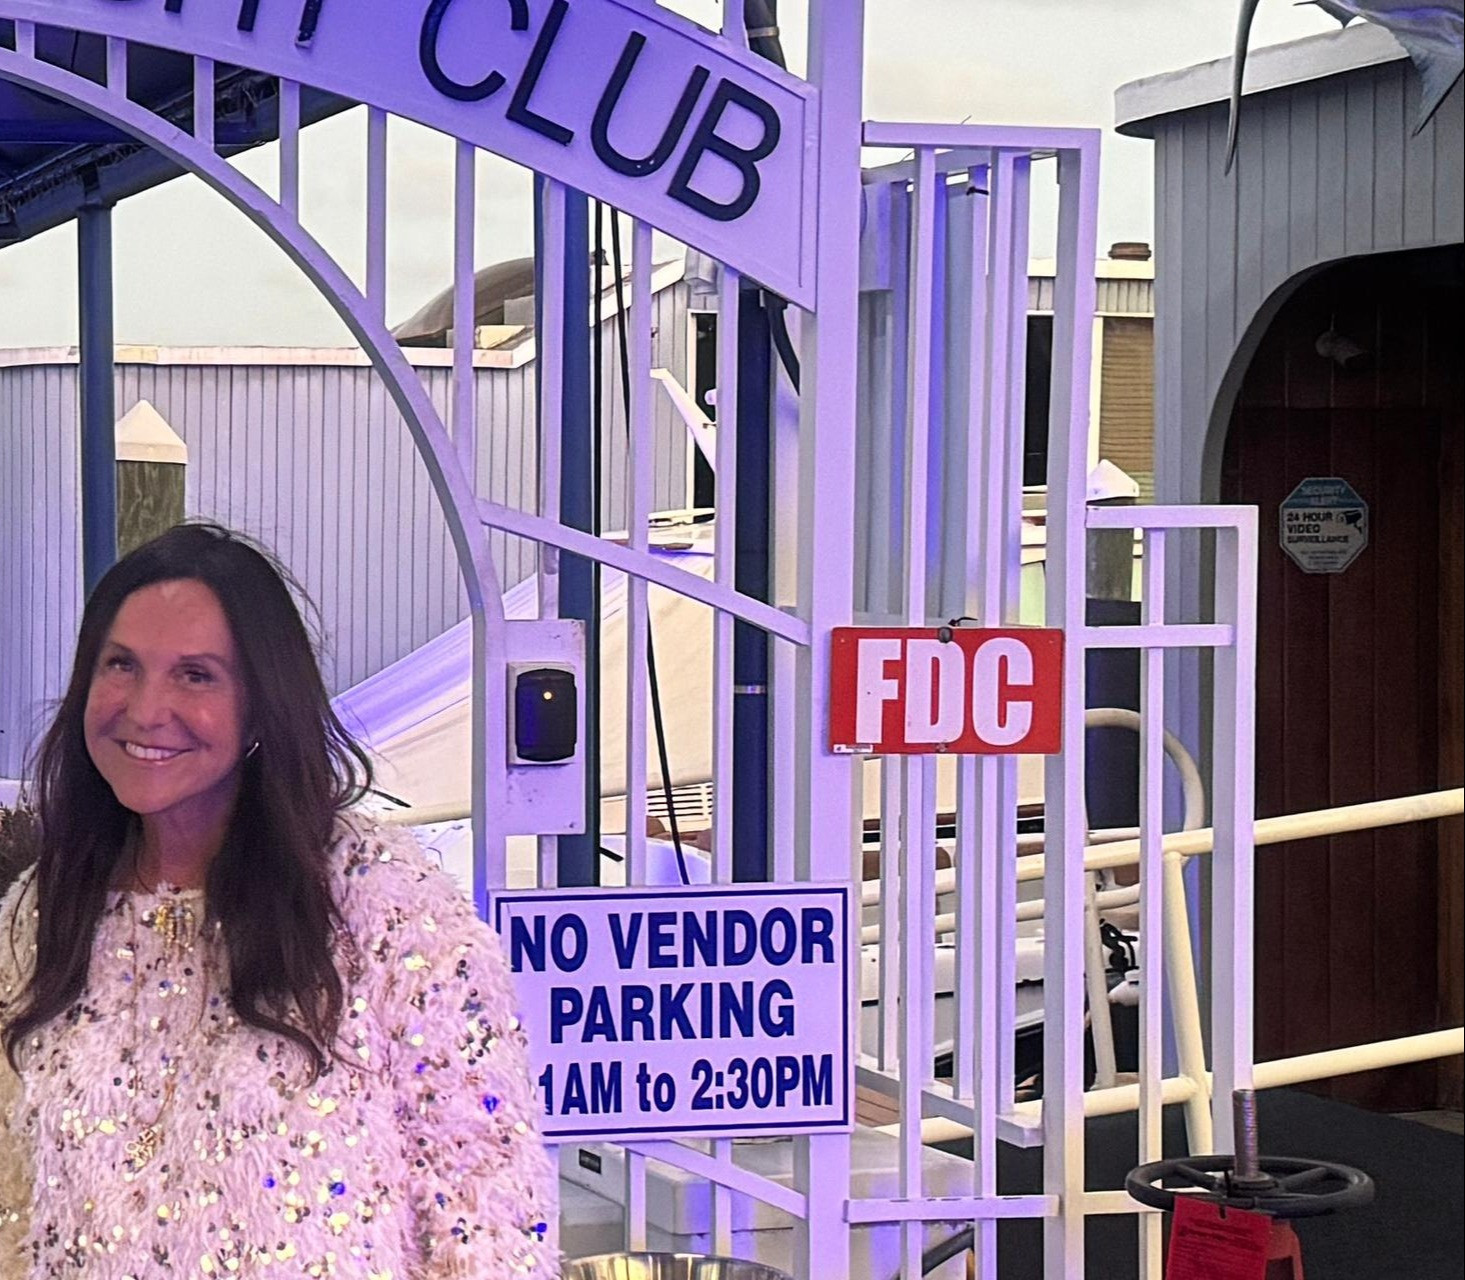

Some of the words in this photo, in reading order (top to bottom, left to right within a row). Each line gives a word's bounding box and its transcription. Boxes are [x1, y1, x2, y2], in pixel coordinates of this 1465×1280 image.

[1287, 523, 1321, 534] VIDEO
[1303, 511, 1333, 522] HOUR
[855, 637, 1034, 746] FDC
[510, 913, 588, 973] NO
[608, 907, 834, 970] VENDOR
[549, 979, 795, 1044] PARKING
[636, 1061, 675, 1112] to
[690, 1053, 833, 1109] 2:30PM
